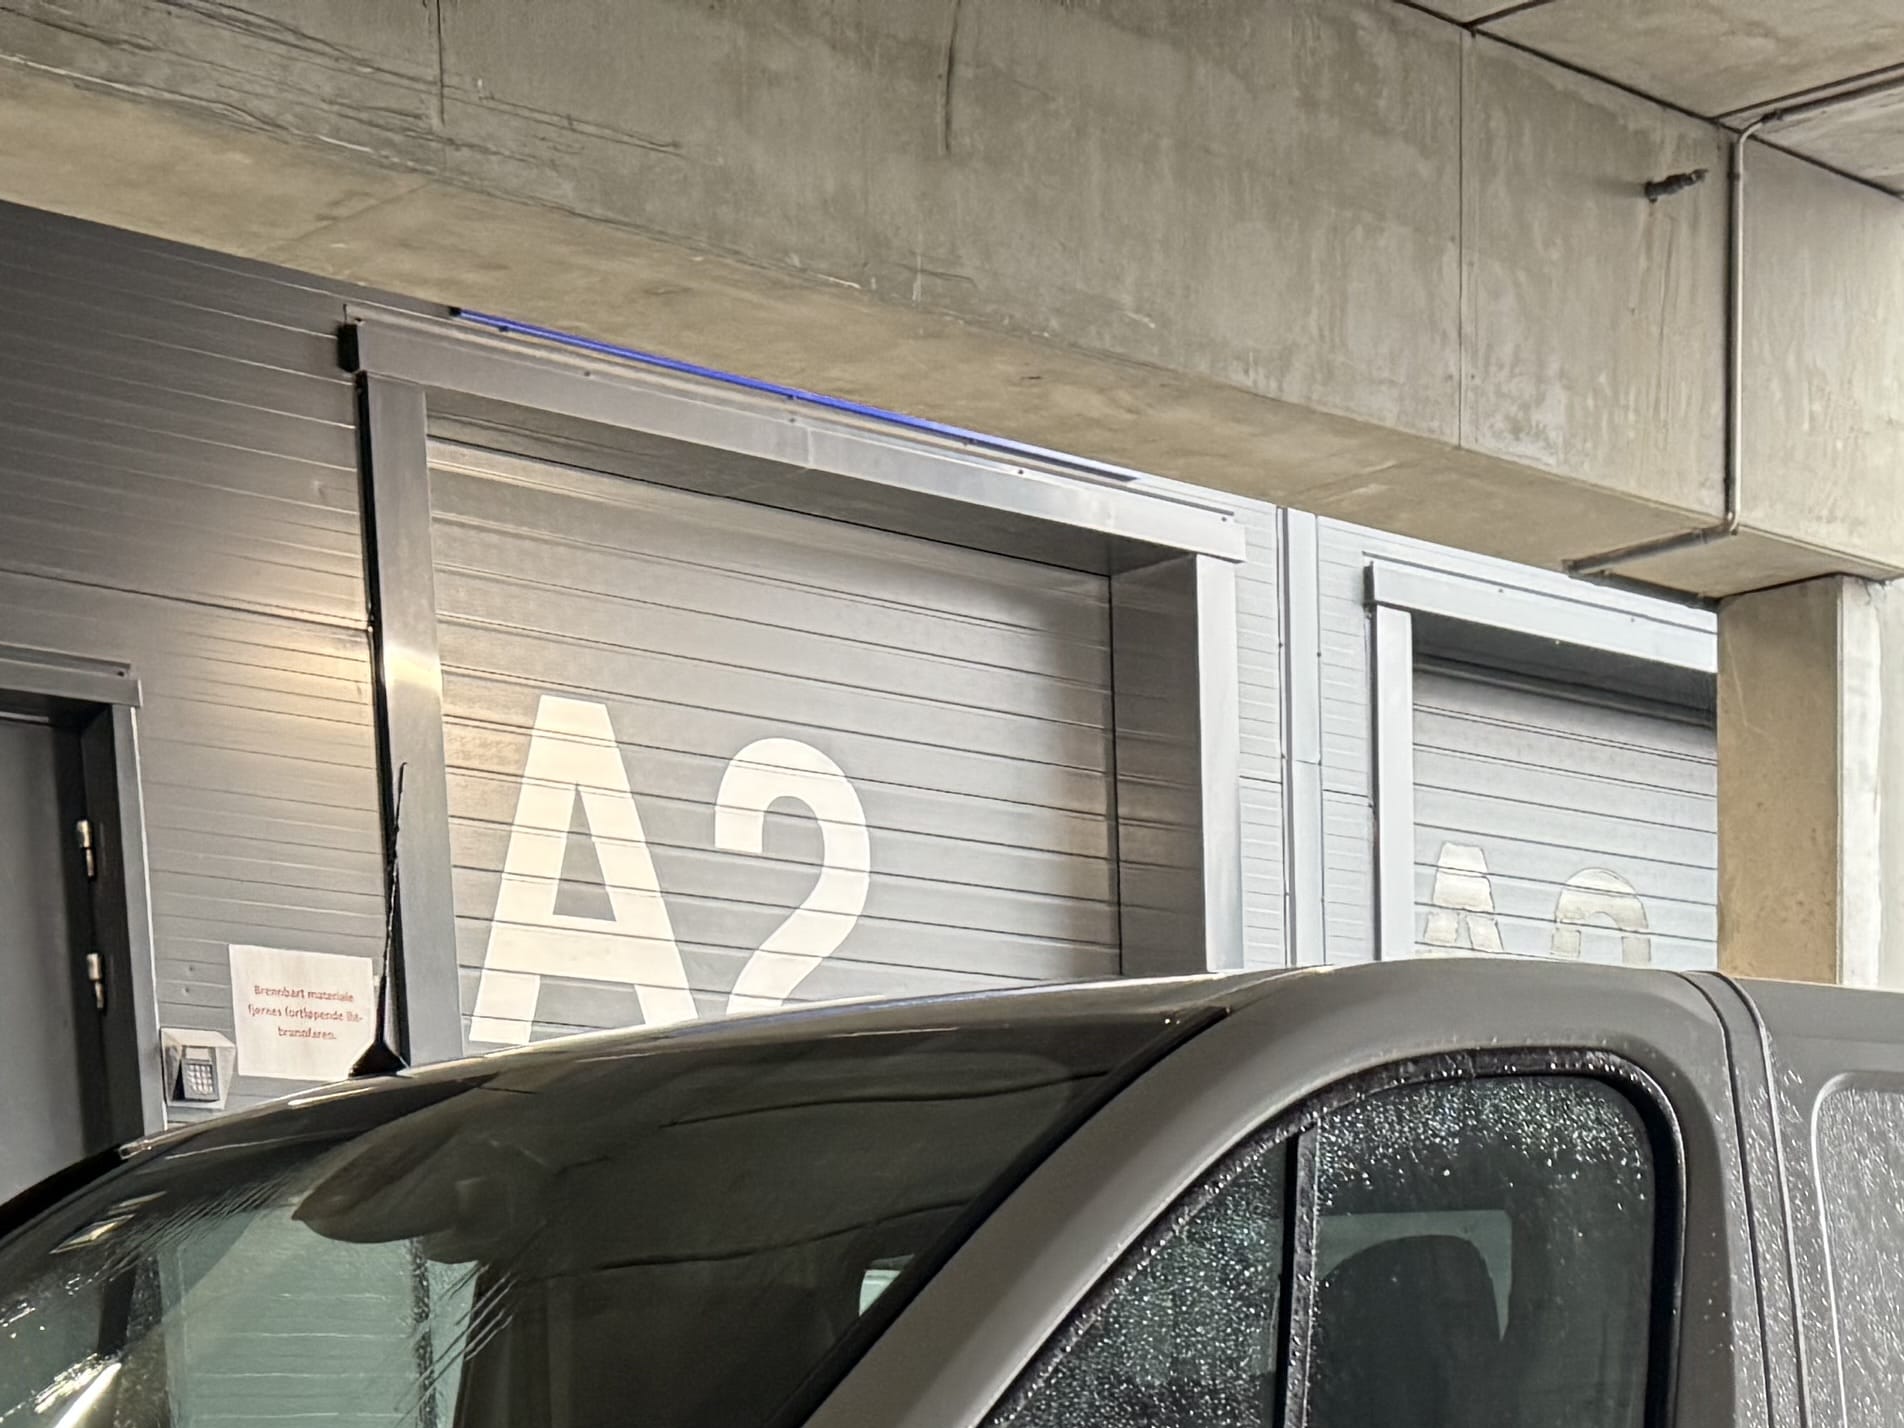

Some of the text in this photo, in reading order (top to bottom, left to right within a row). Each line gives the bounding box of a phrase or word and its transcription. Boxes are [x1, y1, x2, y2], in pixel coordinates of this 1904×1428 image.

[469, 695, 871, 1043] A2
[254, 985, 305, 999] Brennbart
[248, 1003, 281, 1017] fjernes
